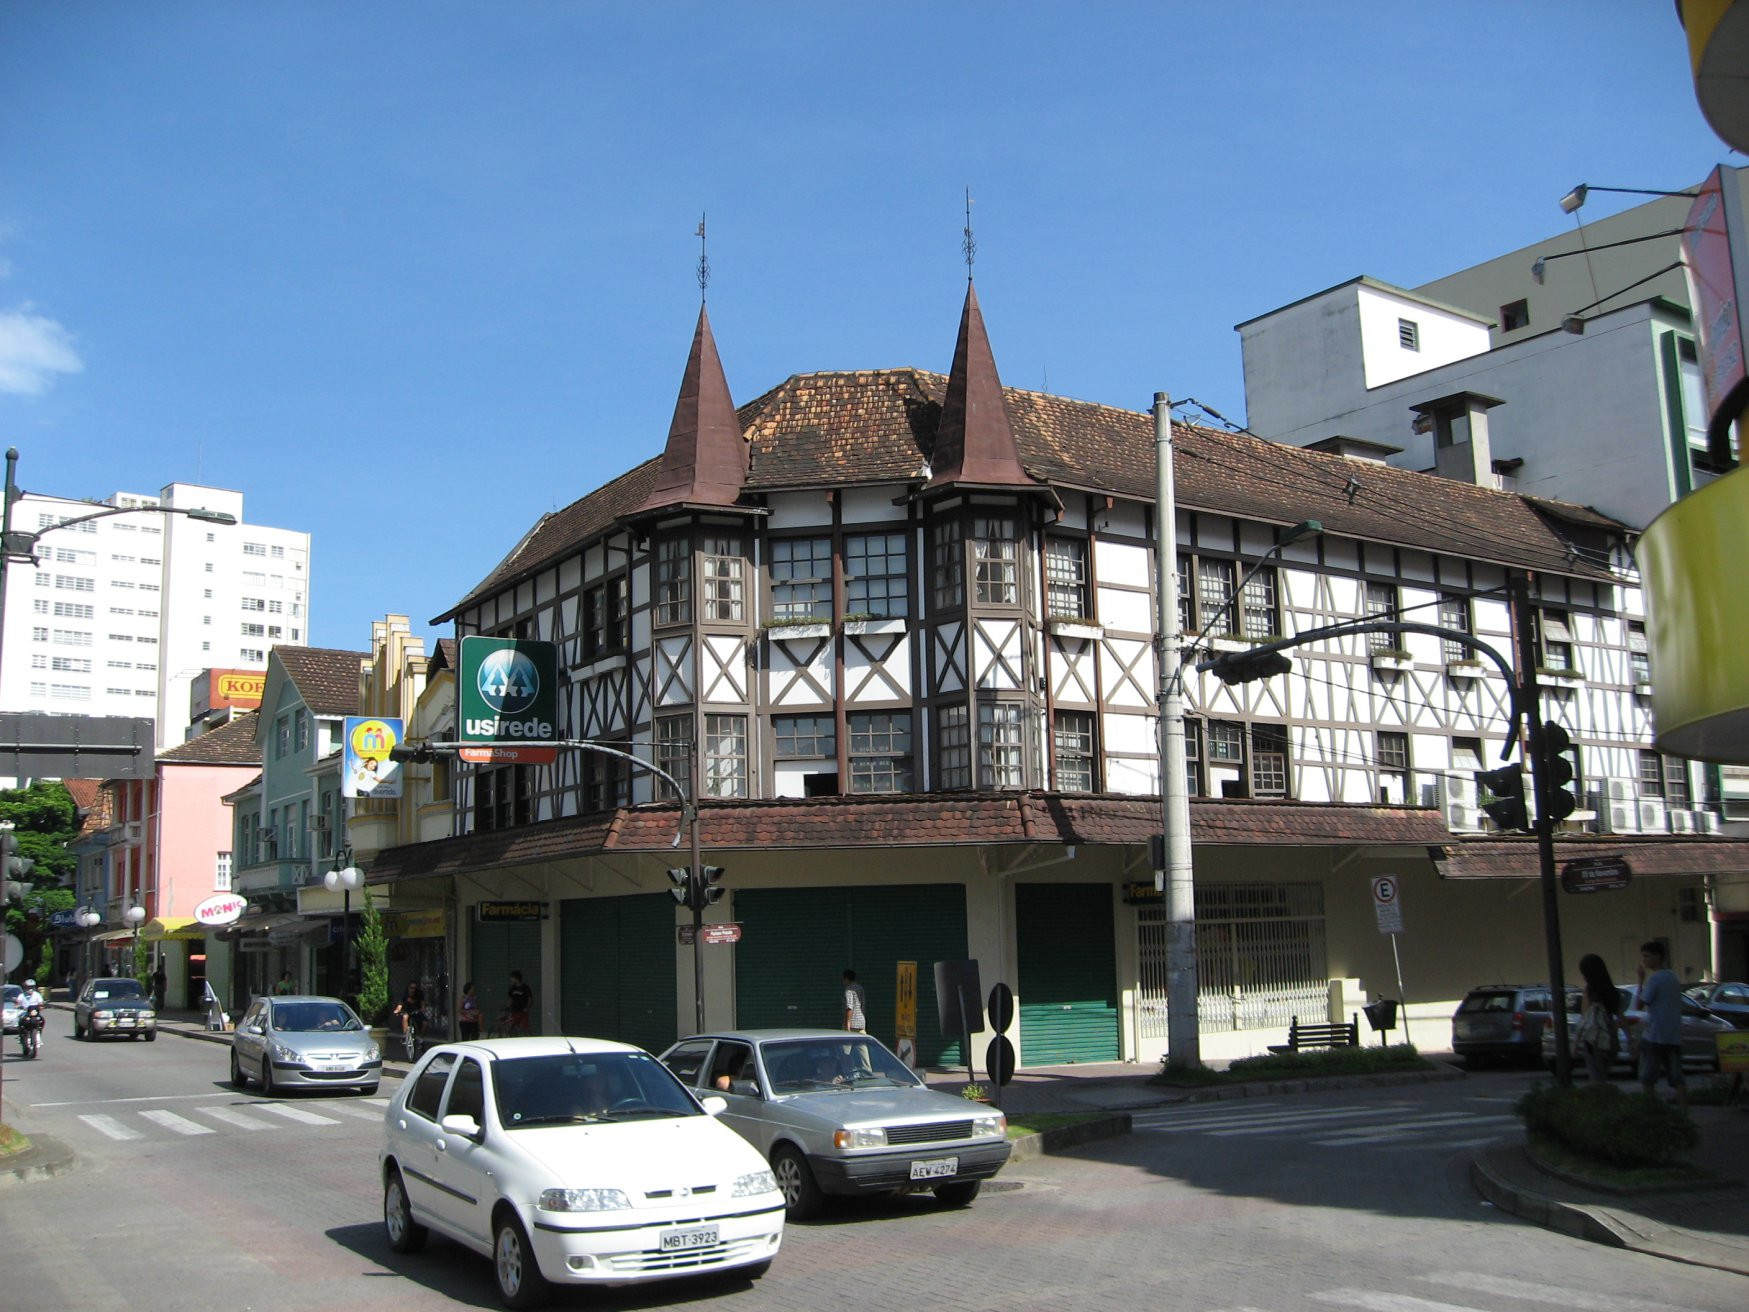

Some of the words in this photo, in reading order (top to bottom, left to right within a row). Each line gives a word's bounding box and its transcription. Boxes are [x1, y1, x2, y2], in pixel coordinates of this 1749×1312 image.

[466, 715, 552, 738] usirede
[464, 747, 518, 760] FarmaShop
[1380, 882, 1390, 898] E
[482, 902, 539, 916] Farmácia
